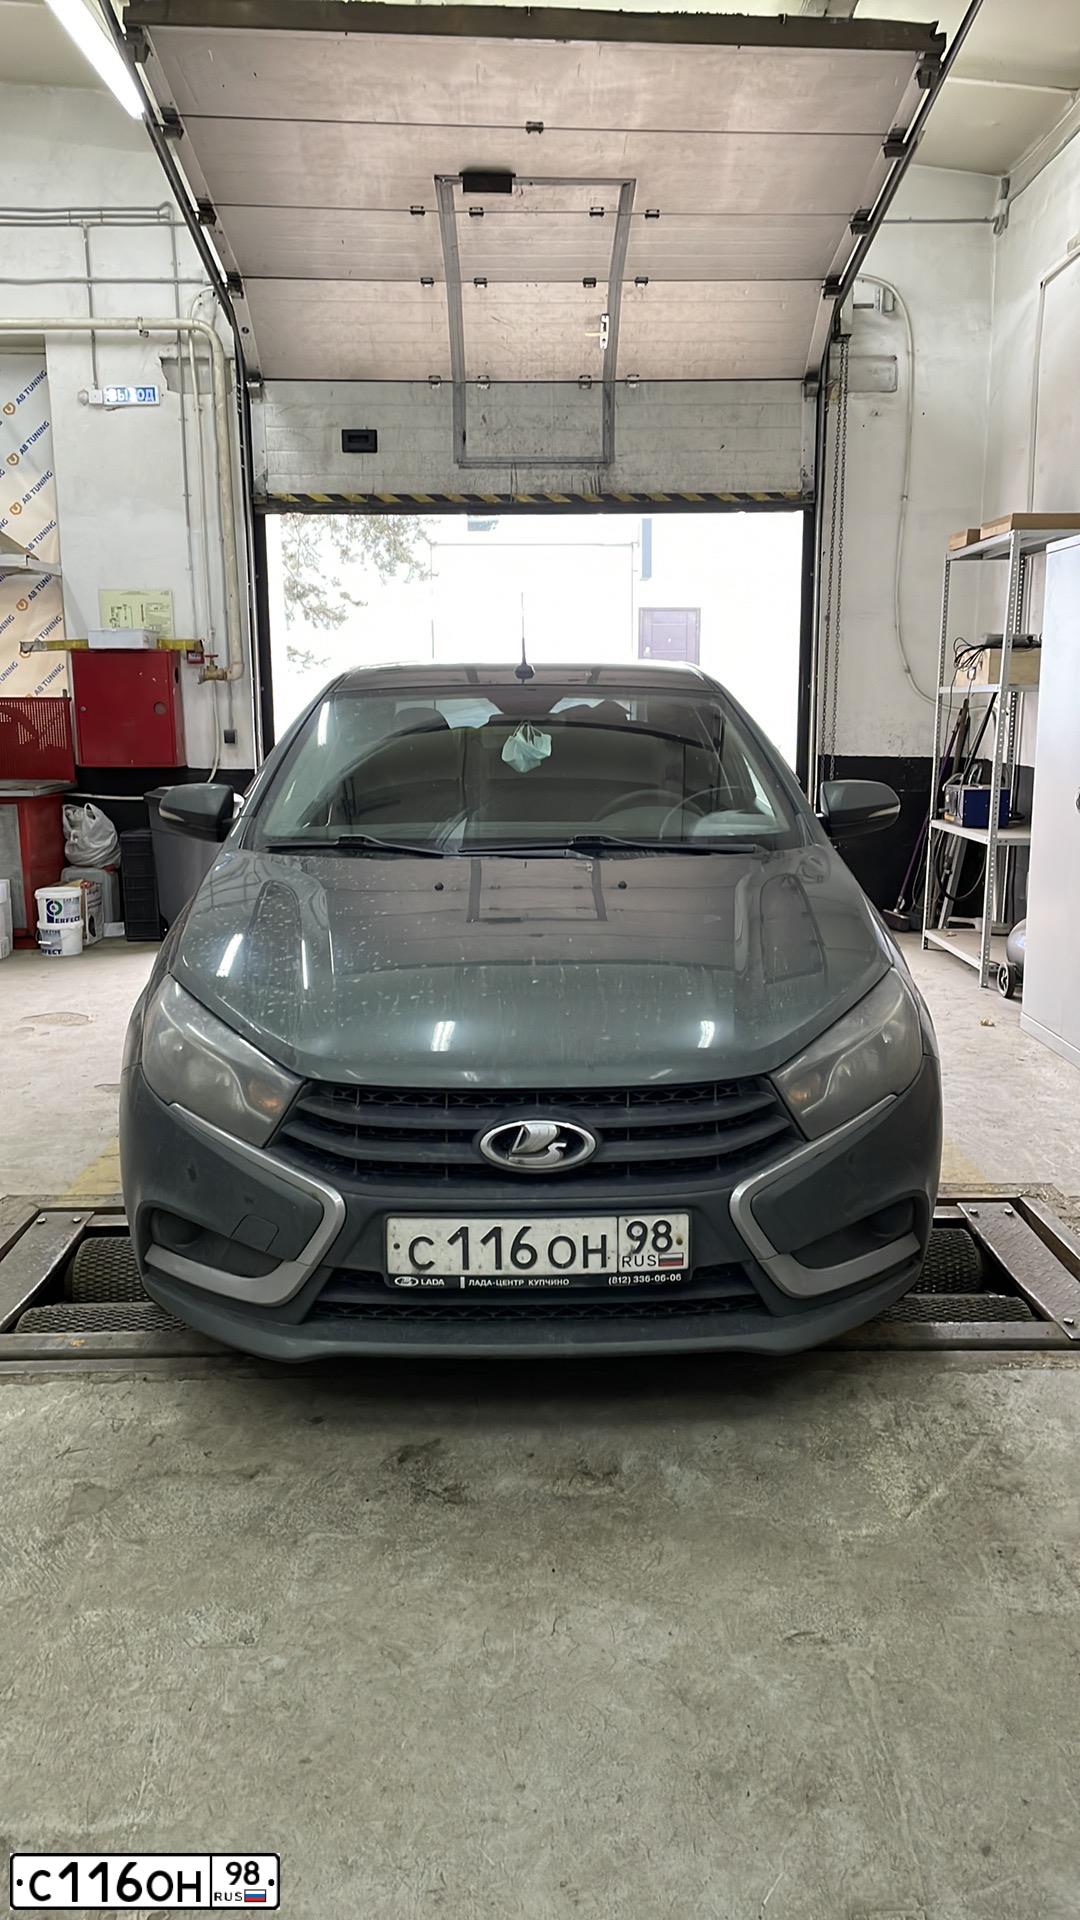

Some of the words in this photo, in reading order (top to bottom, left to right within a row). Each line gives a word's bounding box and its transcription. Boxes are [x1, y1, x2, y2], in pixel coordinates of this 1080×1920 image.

[15, 393, 26, 405] AB
[24, 369, 48, 395] TUNING
[108, 387, 155, 402] ЫОД
[19, 443, 29, 456] AB
[26, 420, 50, 445] TUNING
[22, 493, 32, 504] AB
[30, 470, 53, 495] TUNING
[33, 519, 57, 544] TUNING
[39, 615, 63, 639] TUNING
[0, 661, 19, 684] UNING
[41, 663, 65, 687] TUNING
[626, 1219, 673, 1254] 98
[621, 1253, 657, 1268] RUS
[420, 1278, 445, 1286] LADA
[528, 1277, 570, 1287] КУПЧИНО
[608, 1276, 631, 1286] (812)
